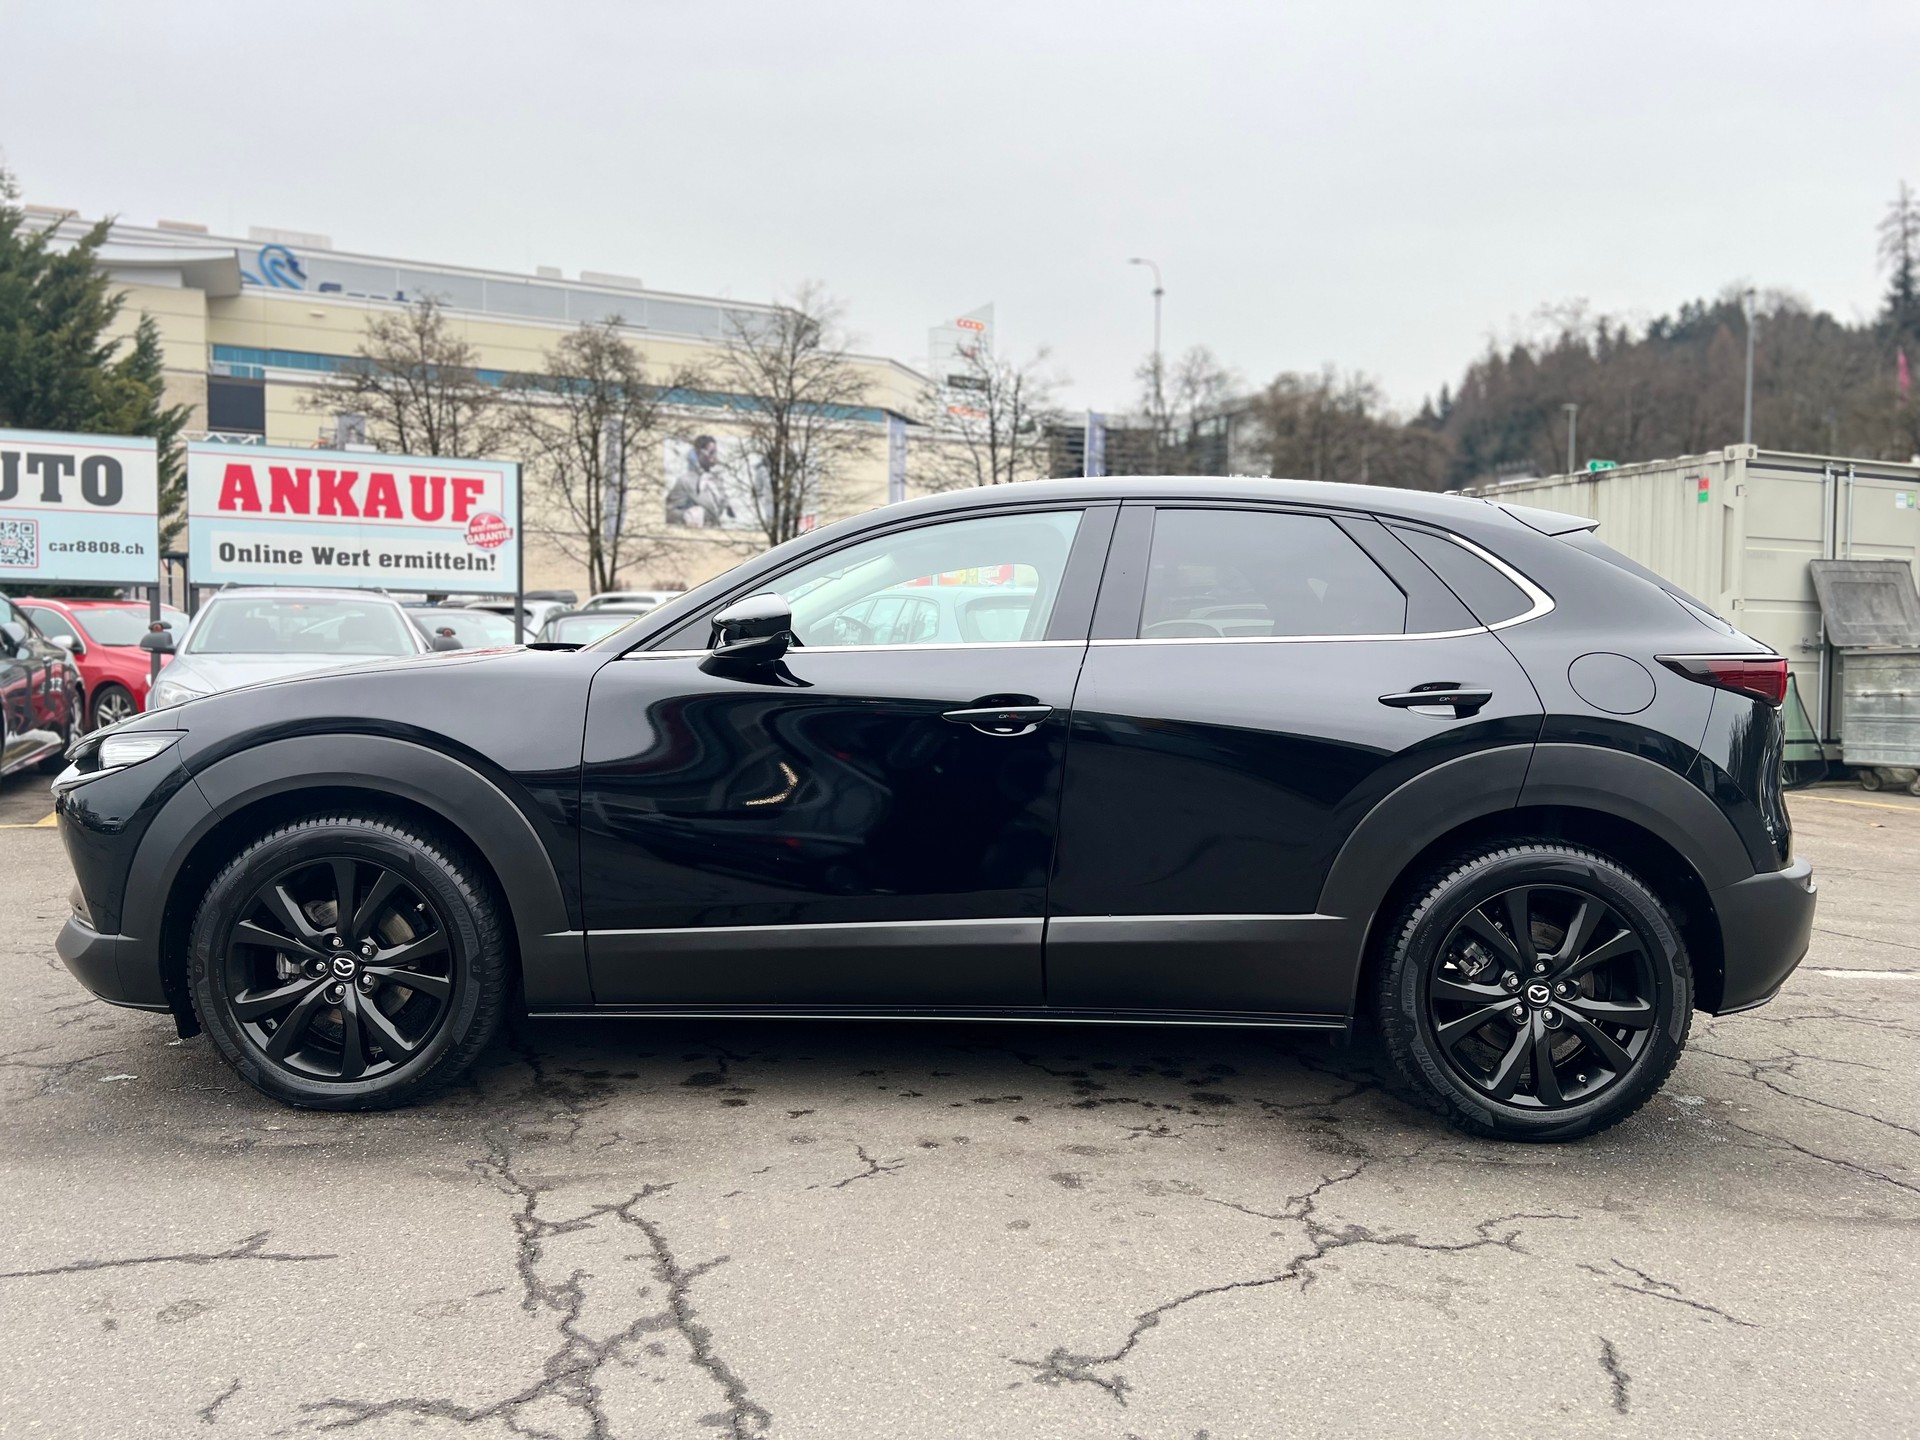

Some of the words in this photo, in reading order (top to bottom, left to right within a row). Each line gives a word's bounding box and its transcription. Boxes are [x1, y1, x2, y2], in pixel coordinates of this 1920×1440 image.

[218, 463, 485, 522] ANKAUF
[48, 540, 144, 555] car8808.ch
[219, 542, 303, 564] Online
[311, 546, 371, 567] Wert
[378, 551, 496, 571] ermitteln!
